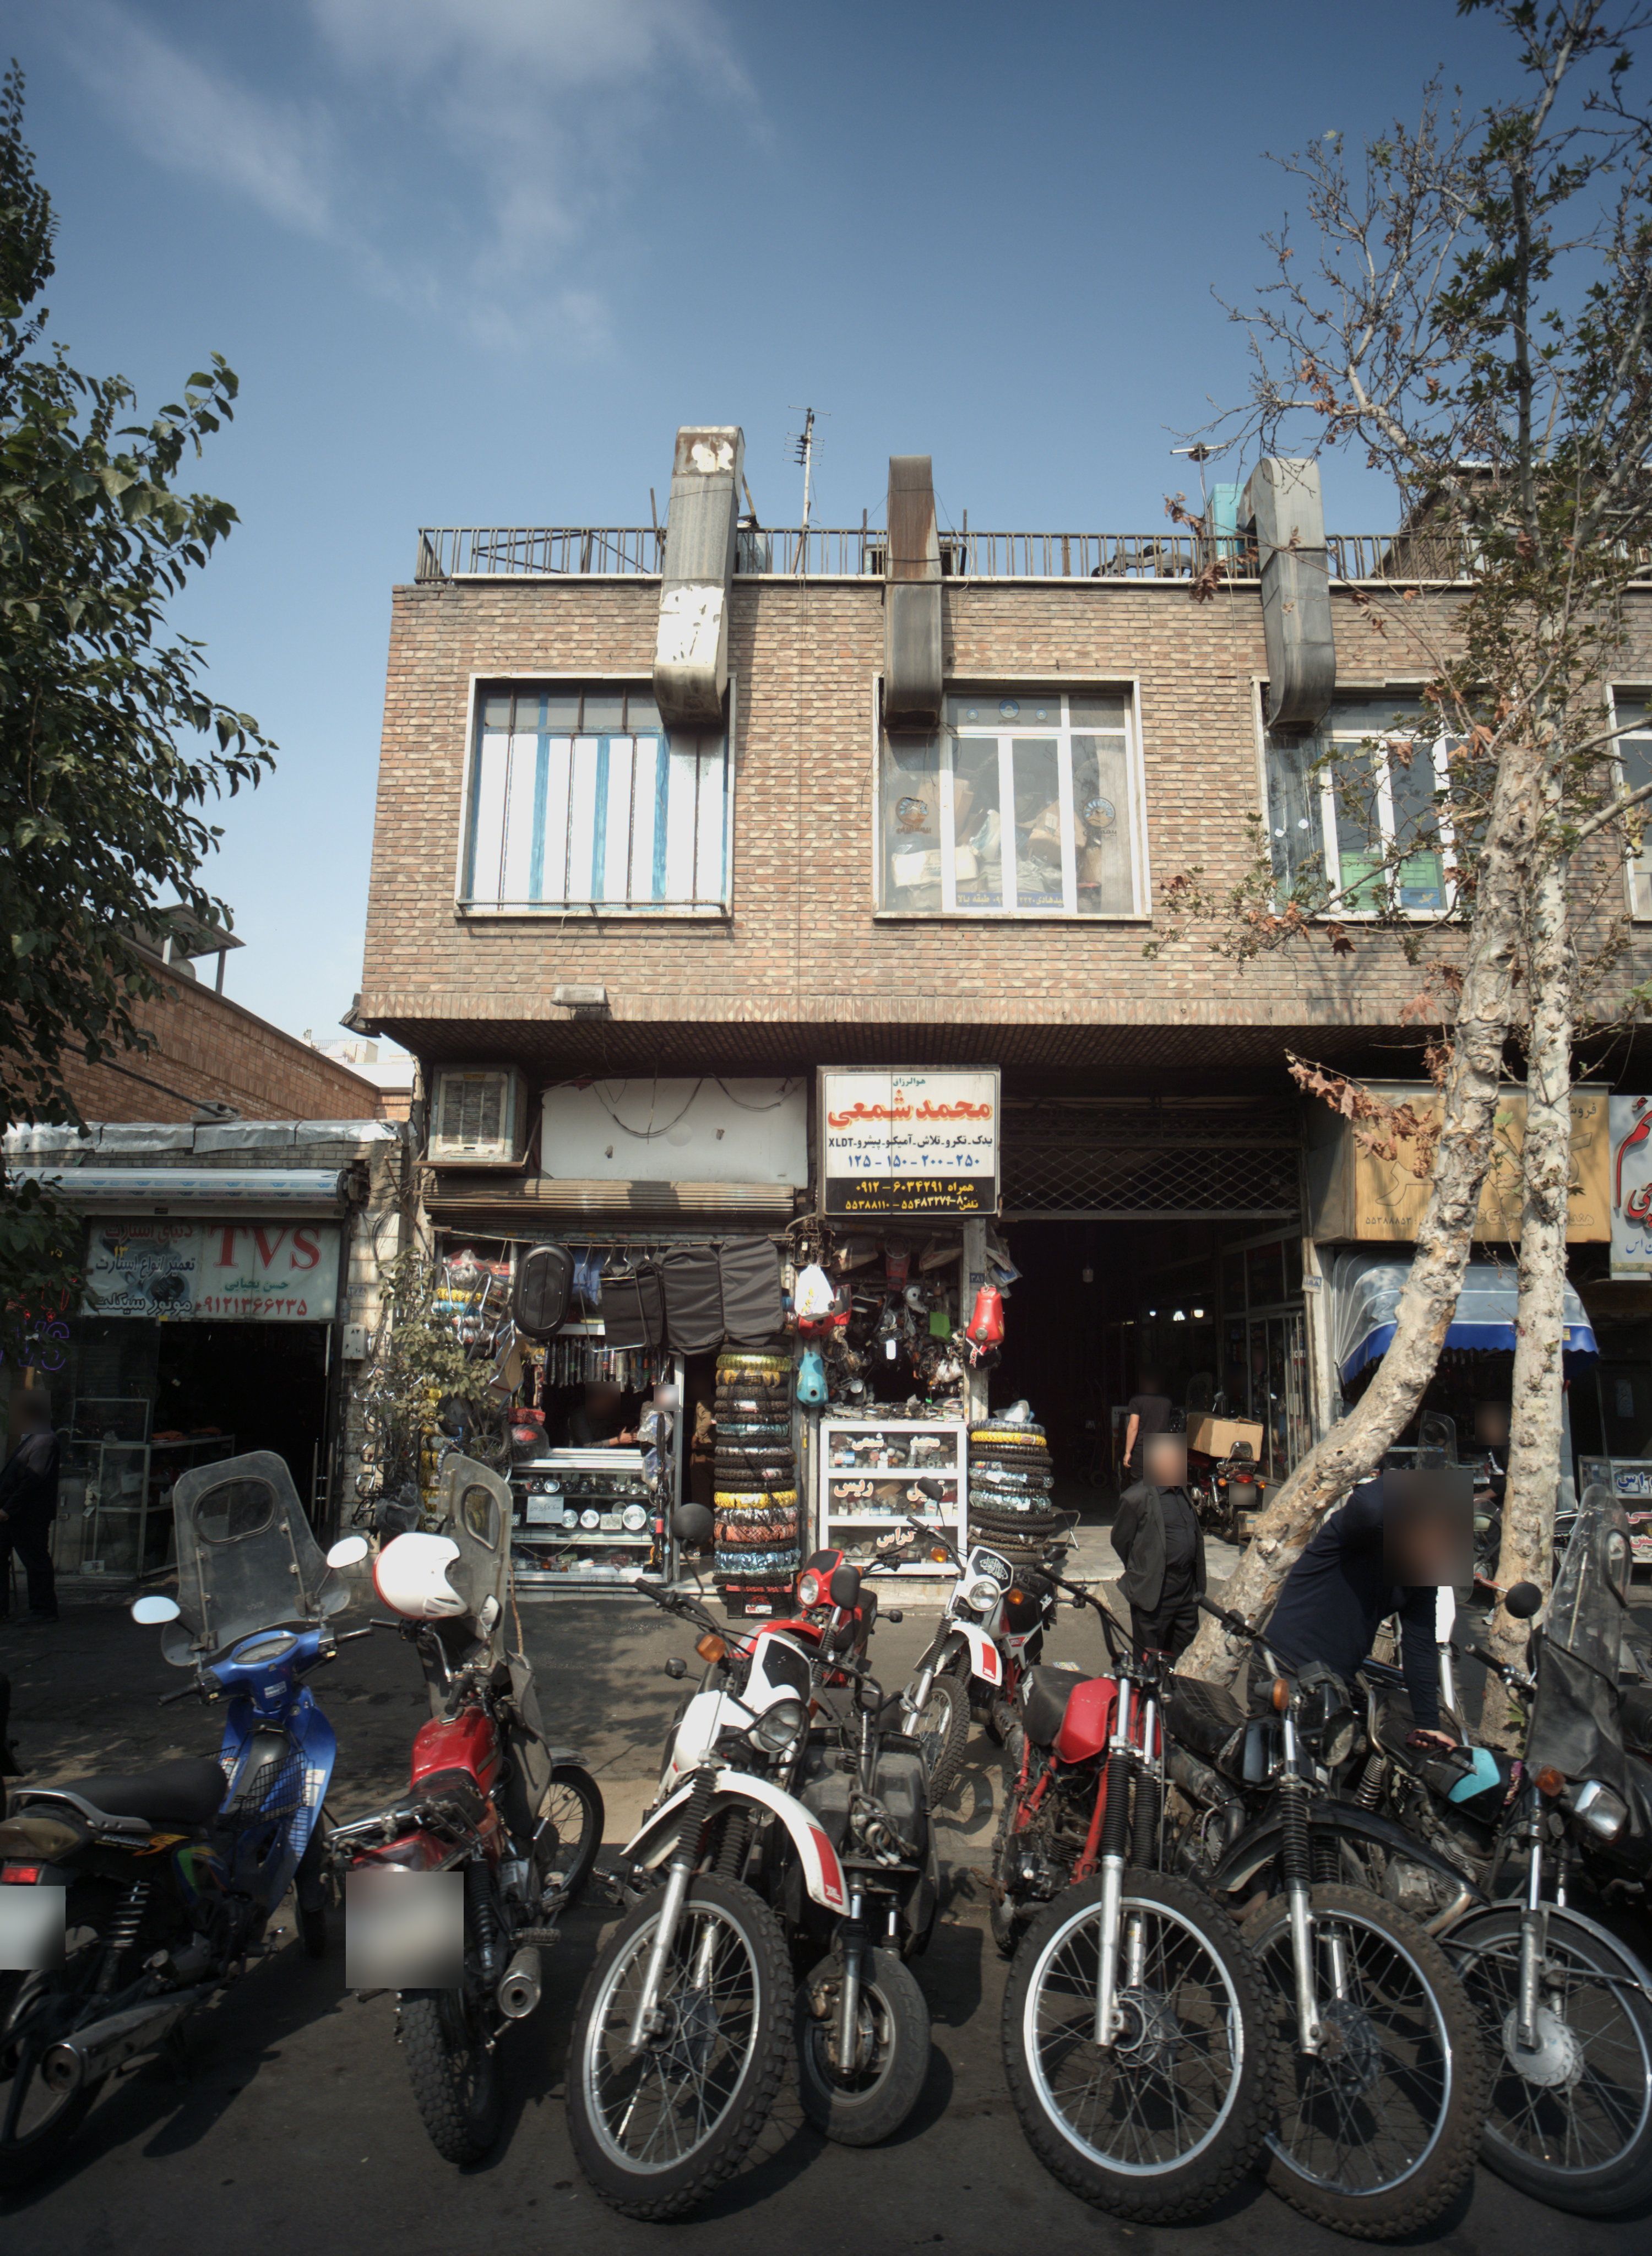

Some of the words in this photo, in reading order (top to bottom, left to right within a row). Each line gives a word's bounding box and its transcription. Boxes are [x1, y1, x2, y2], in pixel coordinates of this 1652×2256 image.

[828, 1089, 912, 1130] شمعی
[916, 1099, 992, 1121] محمد
[849, 1155, 871, 1168] ۱۲۵
[887, 1155, 906, 1168] ۱۵۰
[921, 1154, 942, 1167] ۲۰۰
[956, 1154, 979, 1167] ۲۵۰
[948, 1183, 974, 1194] همراه
[209, 1224, 321, 1270] TVS
[147, 1297, 193, 1316] موتور
